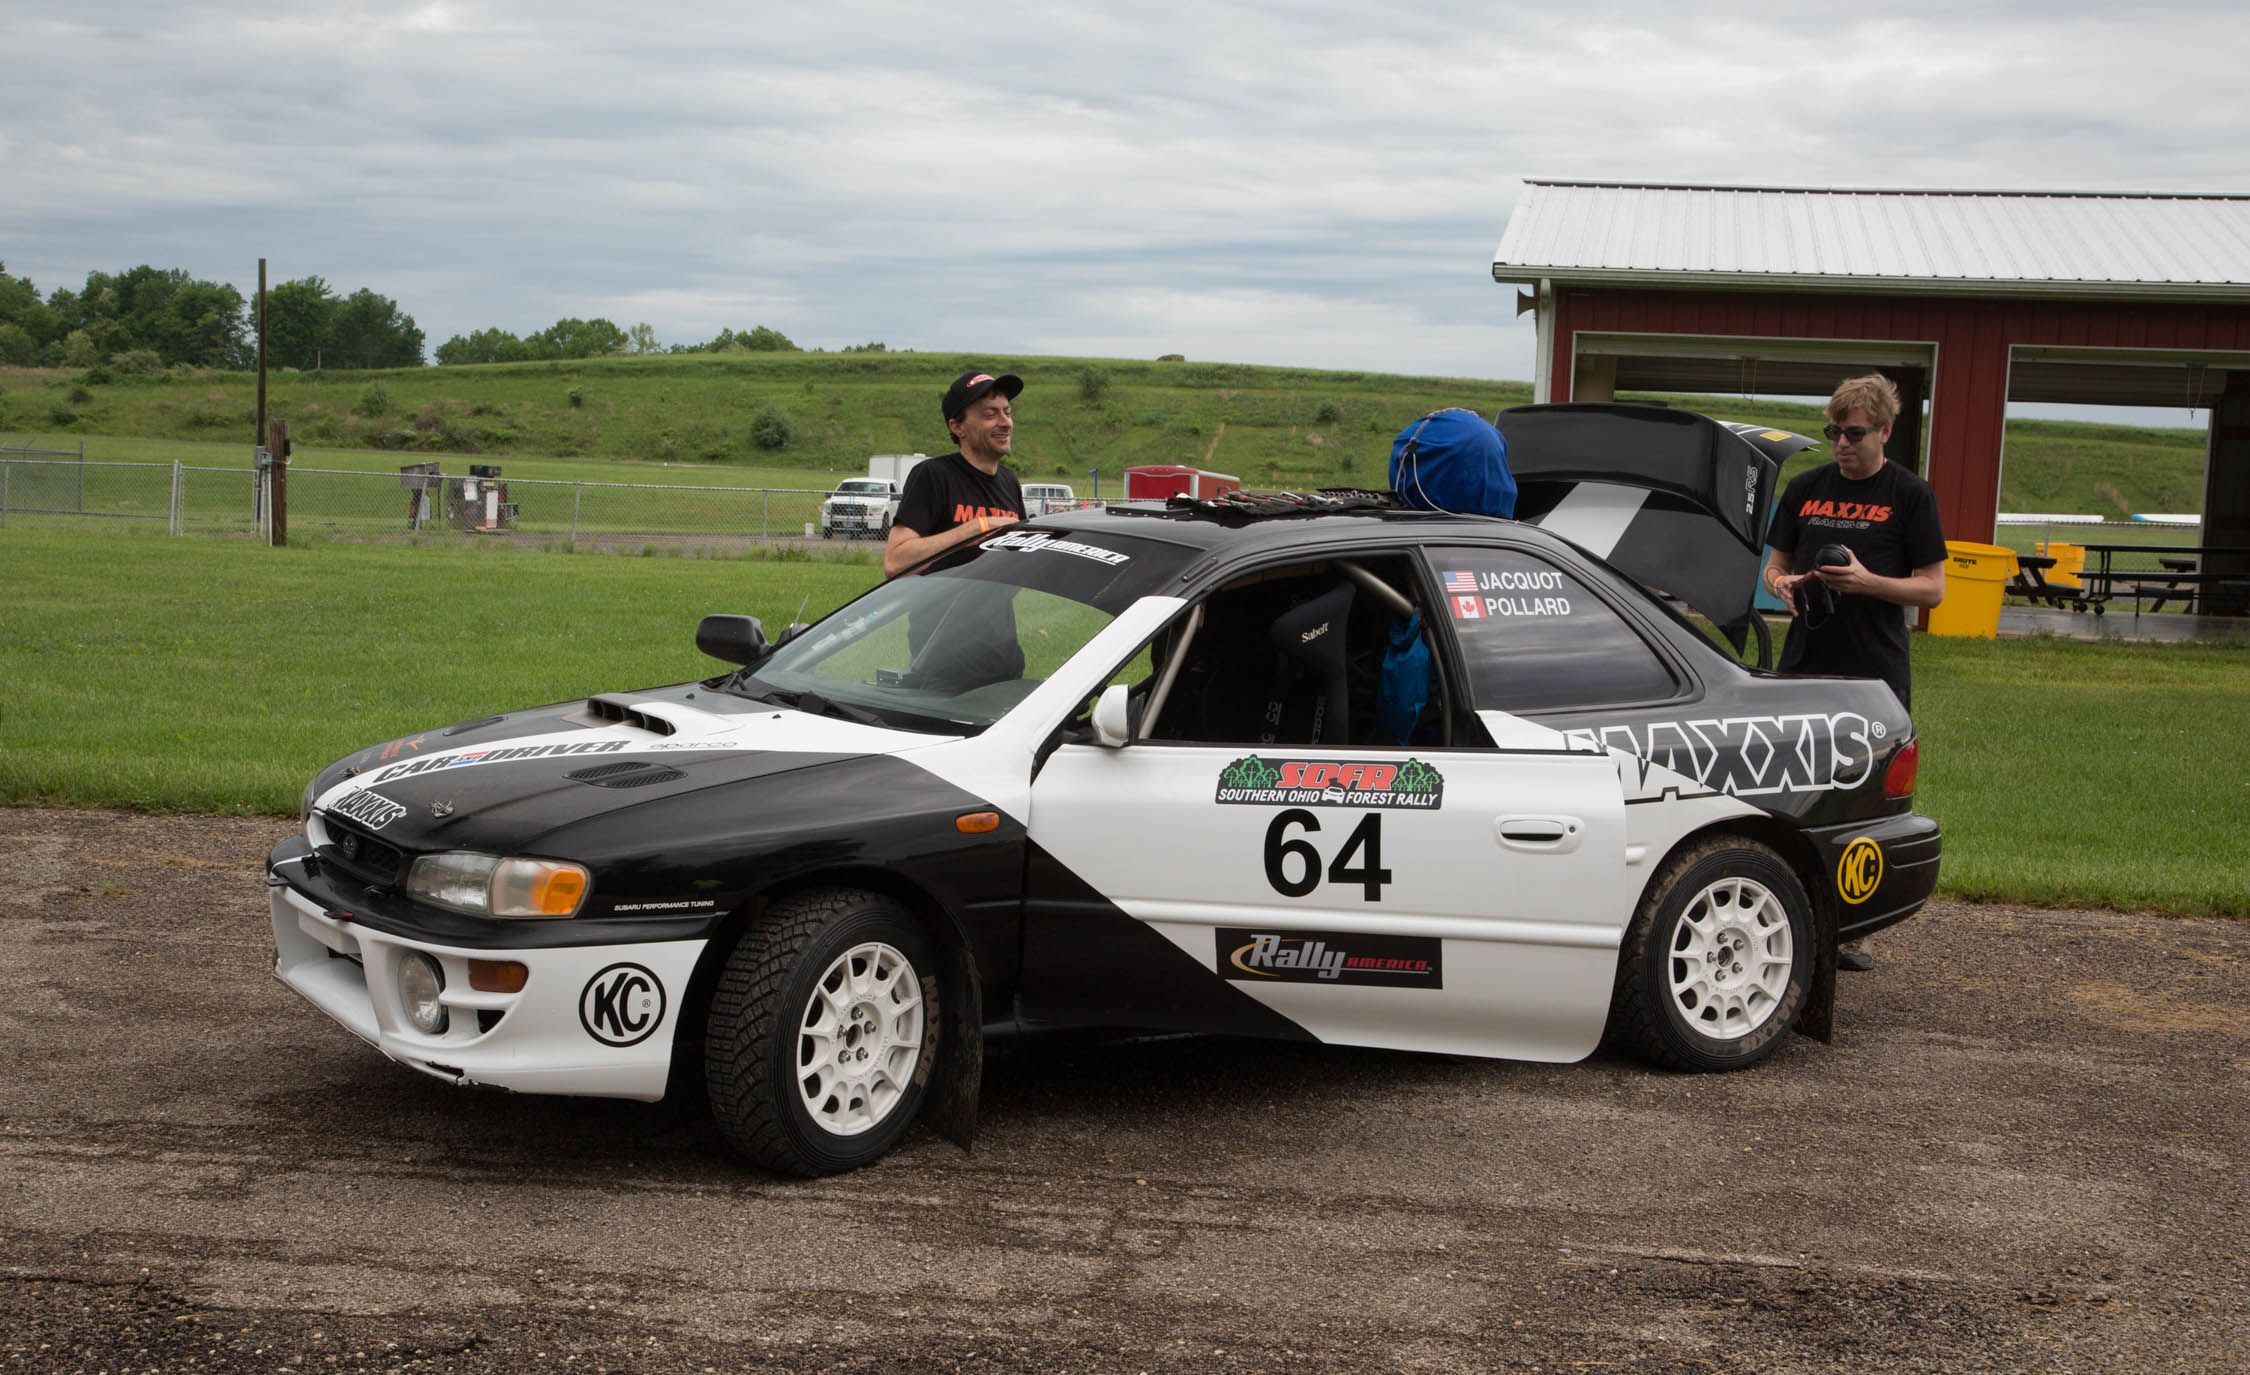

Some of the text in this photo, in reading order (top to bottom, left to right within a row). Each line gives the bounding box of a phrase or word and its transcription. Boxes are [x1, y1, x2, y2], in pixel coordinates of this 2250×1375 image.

[1799, 500, 1893, 522] MAXXIS
[1047, 539, 1131, 564] AMERICA
[1480, 571, 1563, 590] JACQUOT
[1484, 597, 1571, 616] POLLARD
[1301, 621, 1329, 643] Sabelt
[650, 741, 738, 751] sparco
[373, 755, 458, 783] CAR
[478, 741, 631, 763] DRIVER
[1275, 762, 1398, 791] SOFR
[1218, 788, 1438, 806] SOUTHERN OHIO FOREST RALLY
[1264, 808, 1393, 902] 64
[1845, 844, 1876, 897] KC
[614, 904, 641, 912] SUBARU
[642, 901, 689, 910] PERFORMANCE
[1249, 934, 1429, 979] Rally AMERICA
[594, 972, 651, 1037] KC
